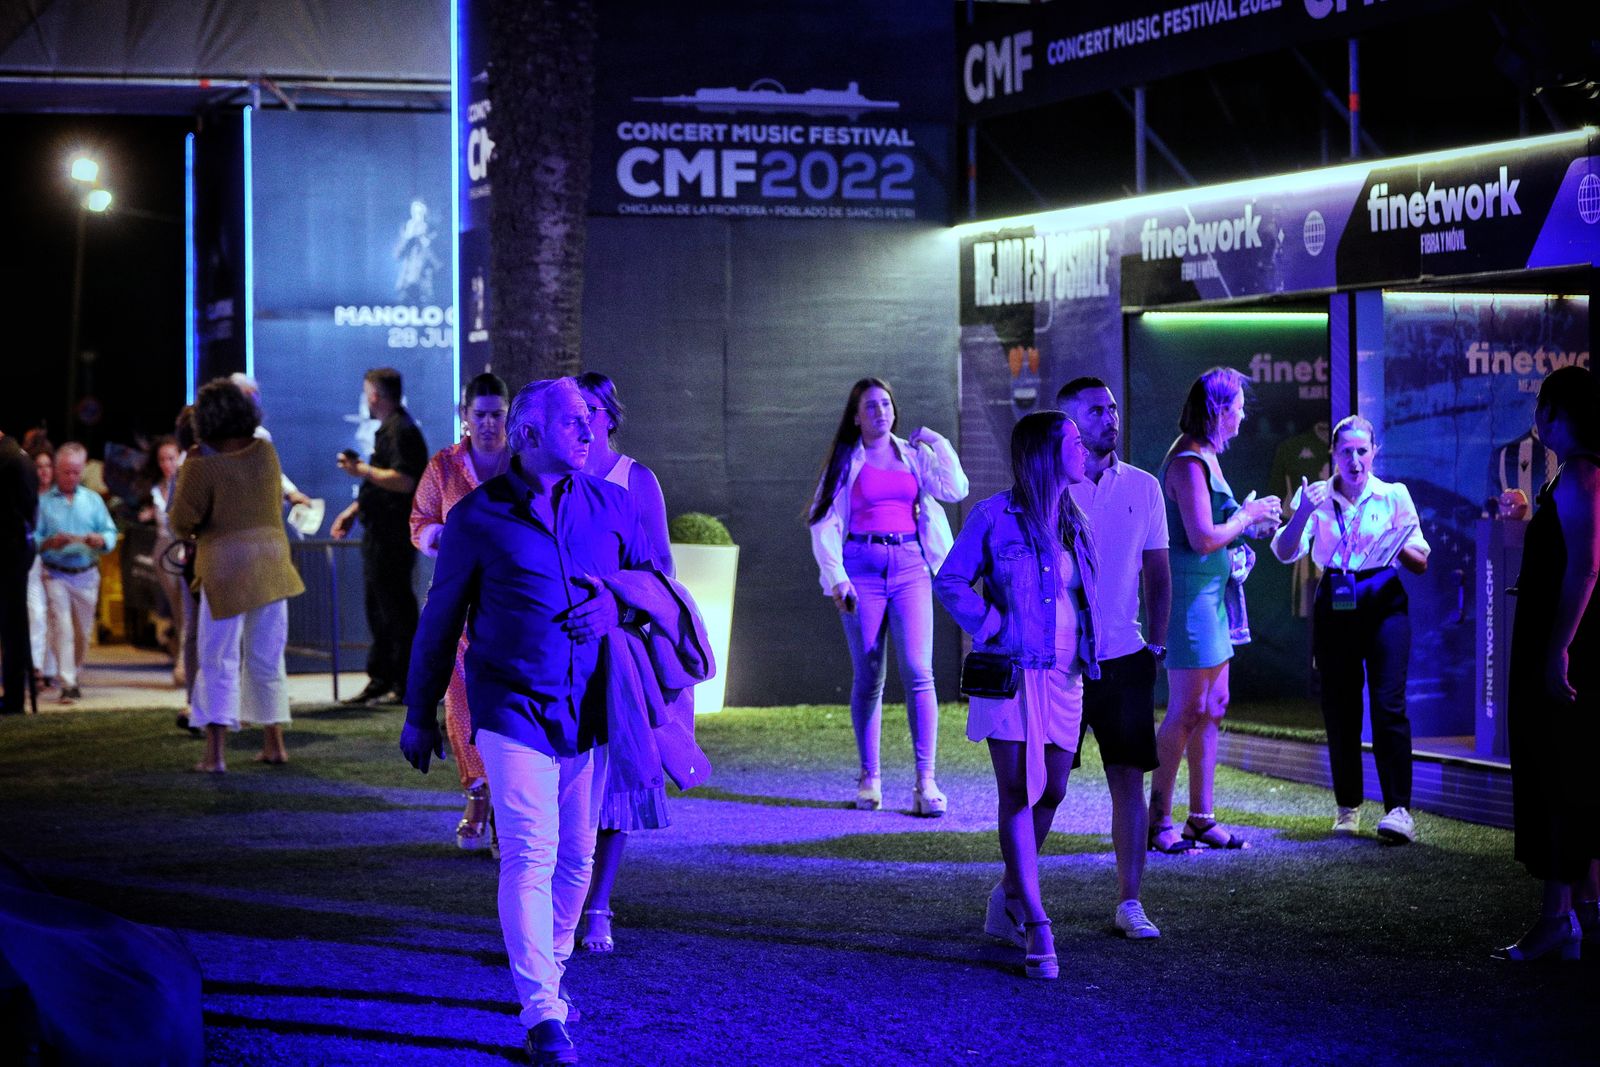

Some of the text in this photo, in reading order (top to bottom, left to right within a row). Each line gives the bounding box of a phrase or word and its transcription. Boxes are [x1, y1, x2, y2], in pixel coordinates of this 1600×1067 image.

[963, 30, 1033, 104] CMF
[1047, 26, 1112, 65] CONCERT
[1113, 14, 1160, 49] MUSIC
[1163, 0, 1237, 37] FESTIVAL
[617, 121, 915, 146] CONCERT MUSIC FESTIVAL
[1367, 165, 1522, 233] finetwork
[1140, 203, 1262, 261] finetwork
[1420, 231, 1440, 255] FIBRA
[334, 305, 444, 327] MANOLO
[1248, 353, 1328, 383] finet
